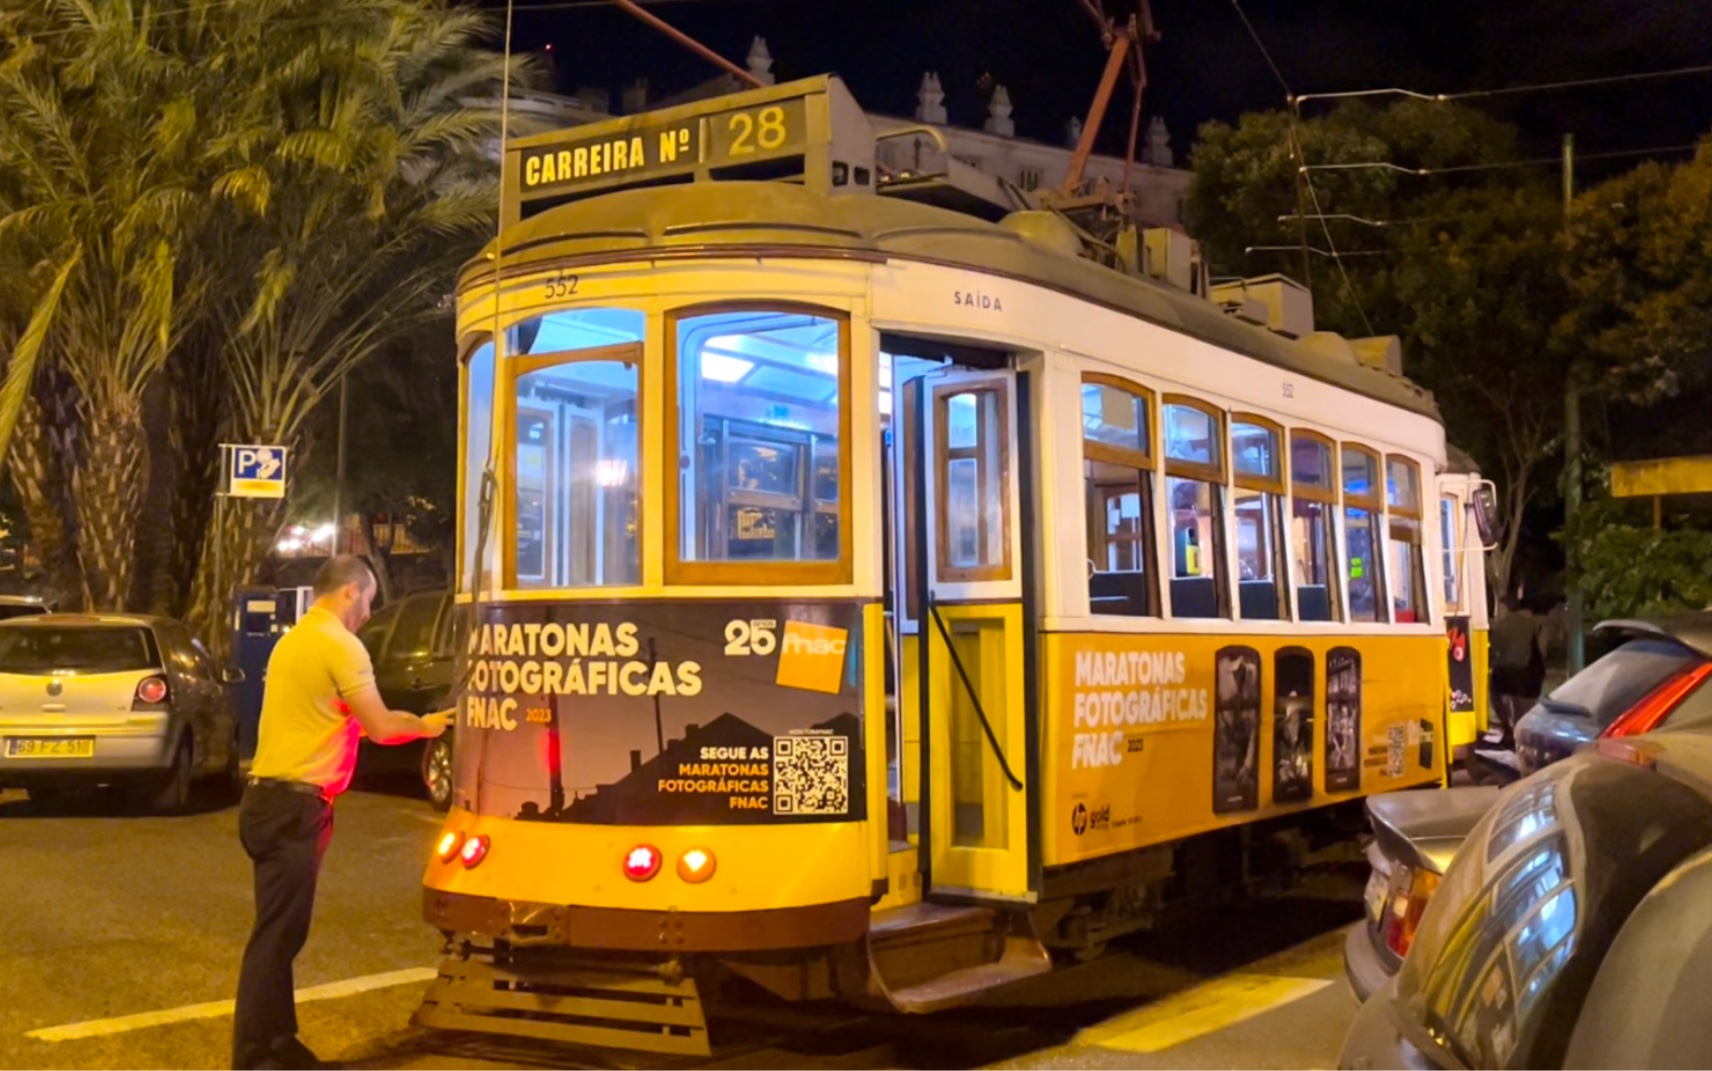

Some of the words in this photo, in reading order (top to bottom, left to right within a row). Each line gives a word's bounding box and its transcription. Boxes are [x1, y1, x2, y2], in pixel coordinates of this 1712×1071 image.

[525, 137, 644, 186] CARREIRA
[728, 106, 786, 156] 28
[545, 275, 579, 299] 552
[954, 290, 1002, 312] SAÍDA
[239, 450, 256, 474] P
[724, 619, 777, 656] 25
[783, 632, 846, 655] fnac
[1075, 651, 1185, 687] MARATONAS
[467, 696, 518, 731] FNAC
[525, 708, 552, 722] 2023
[1074, 686, 1208, 728] FOTOGRÁFICAS
[700, 746, 747, 760] SEGUE
[749, 746, 769, 760] AS
[1072, 730, 1123, 769] FNAC
[679, 763, 769, 776] MARATONAS
[658, 776, 769, 793] FOTOGRÁFICAS
[729, 796, 769, 809] FNAC
